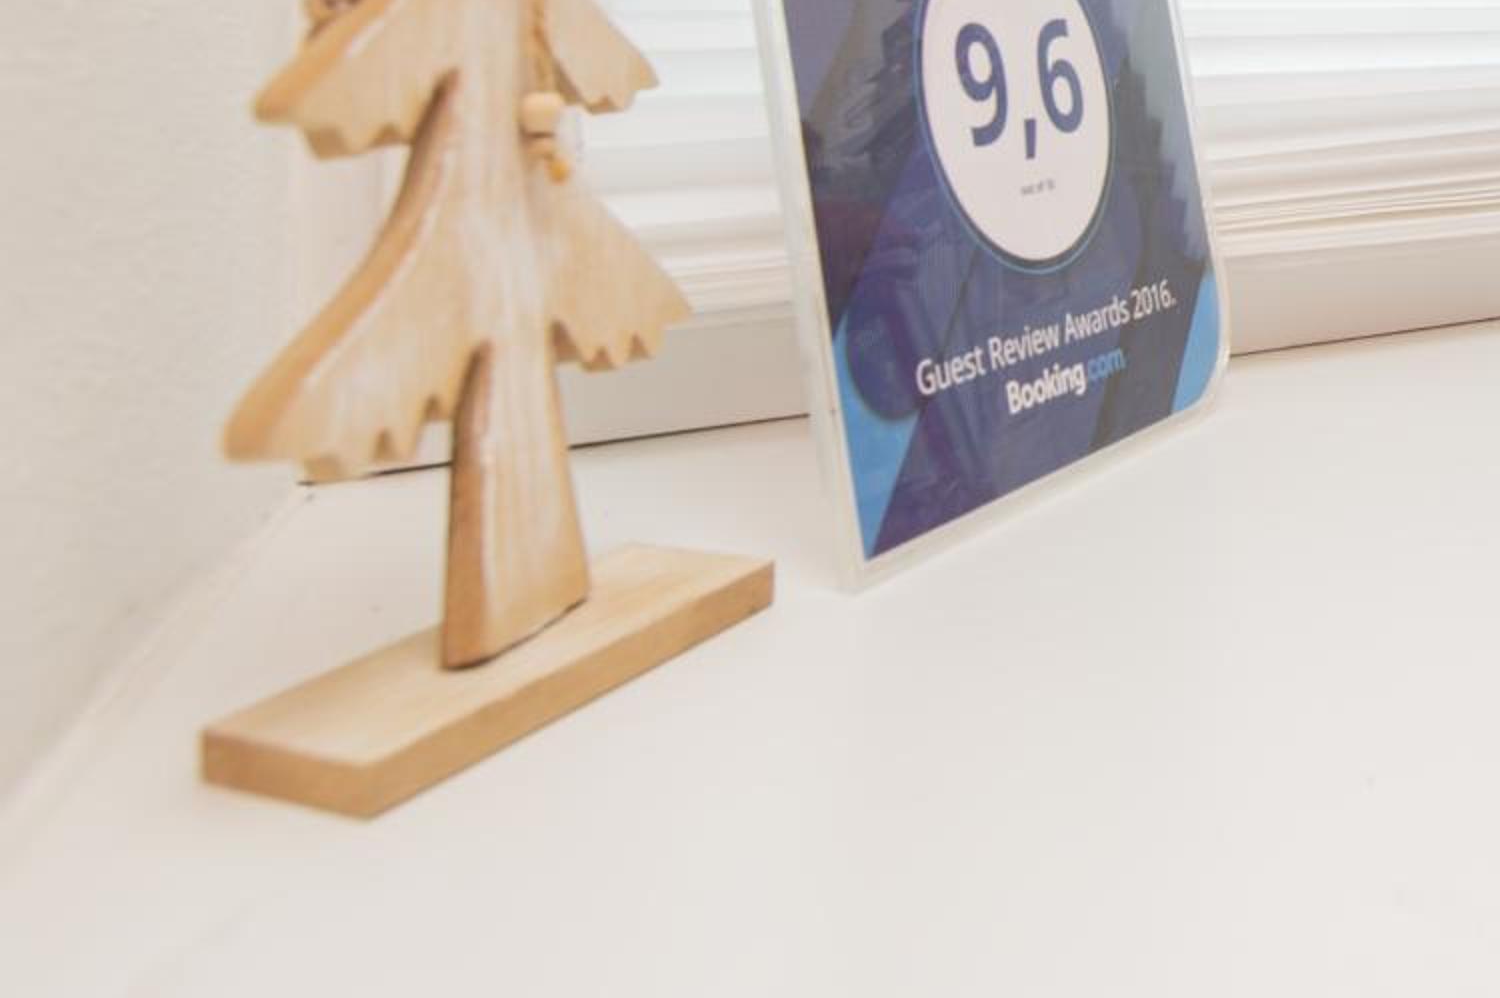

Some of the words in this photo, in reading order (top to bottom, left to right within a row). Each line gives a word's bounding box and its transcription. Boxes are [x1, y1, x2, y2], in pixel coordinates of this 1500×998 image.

[954, 18, 1084, 160] 9,6
[916, 345, 986, 395] Guest
[988, 323, 1061, 371] Review
[1064, 295, 1131, 344] Awards
[1131, 278, 1177, 320] 2016.
[1005, 348, 1127, 415] Booking.com
